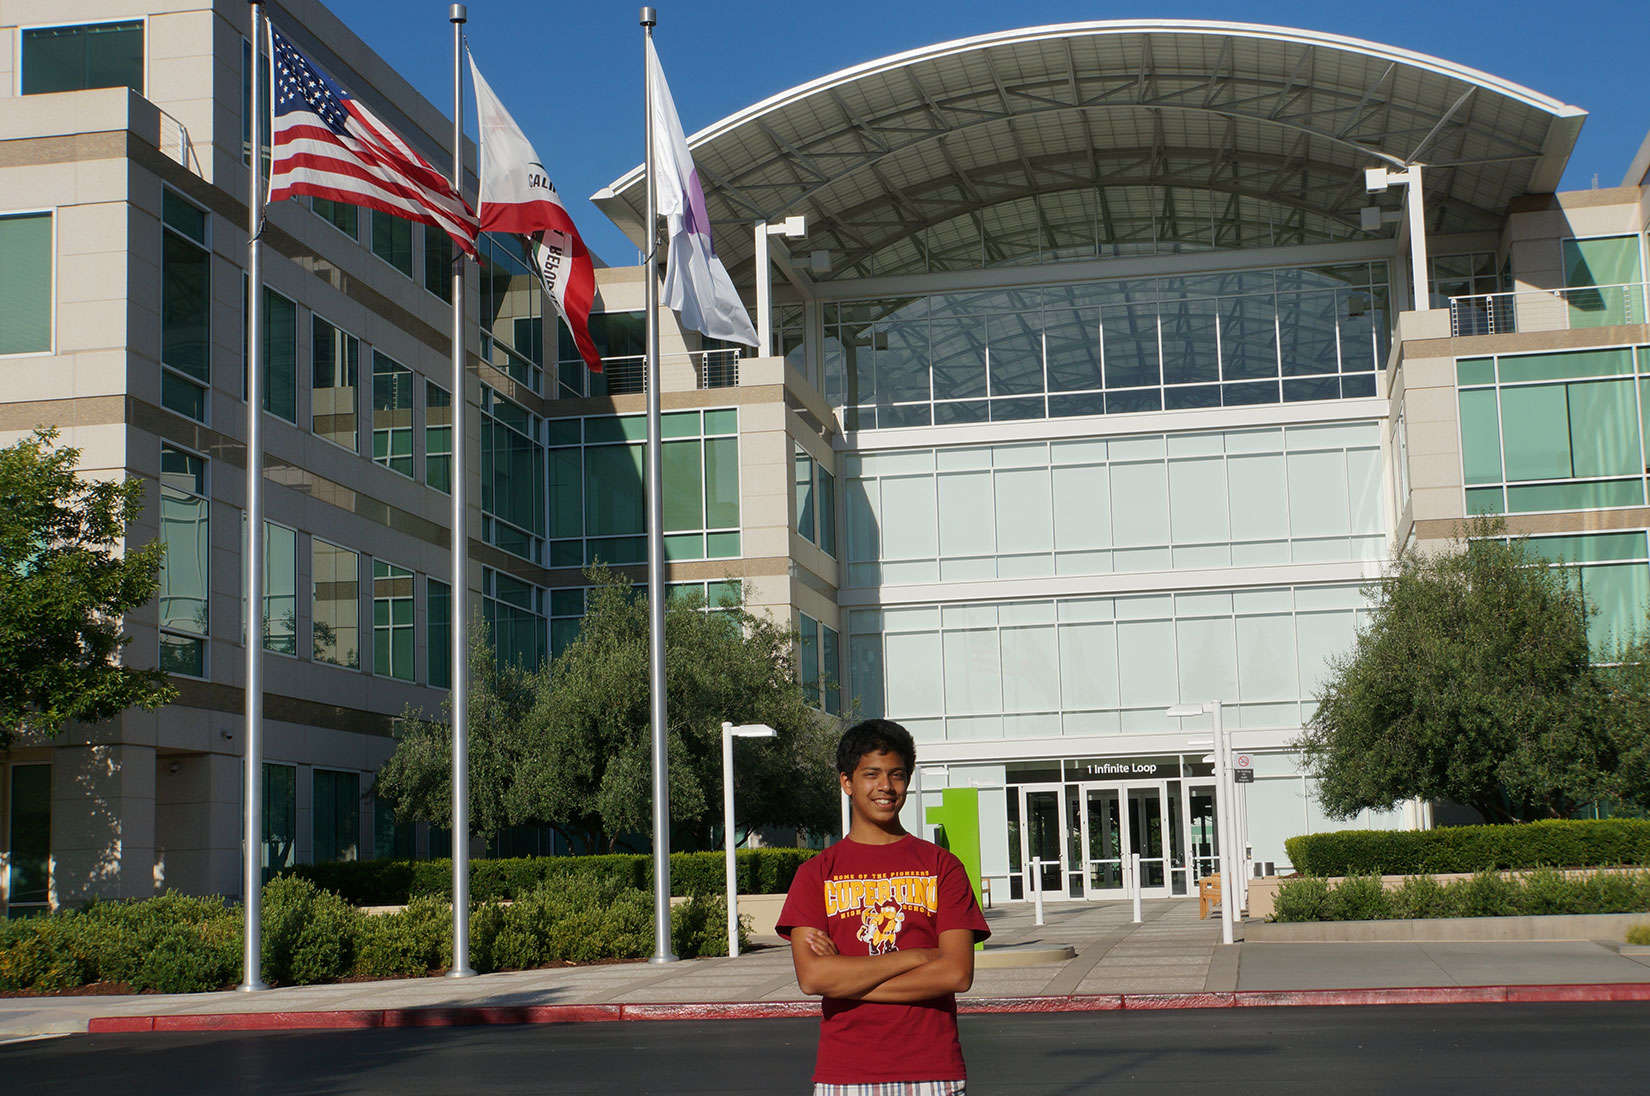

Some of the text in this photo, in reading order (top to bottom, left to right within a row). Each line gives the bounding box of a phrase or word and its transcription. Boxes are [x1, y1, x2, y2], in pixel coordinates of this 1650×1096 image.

[1087, 763, 1157, 774] 1 Infinite Loop
[824, 875, 938, 917] CUPERTINO
